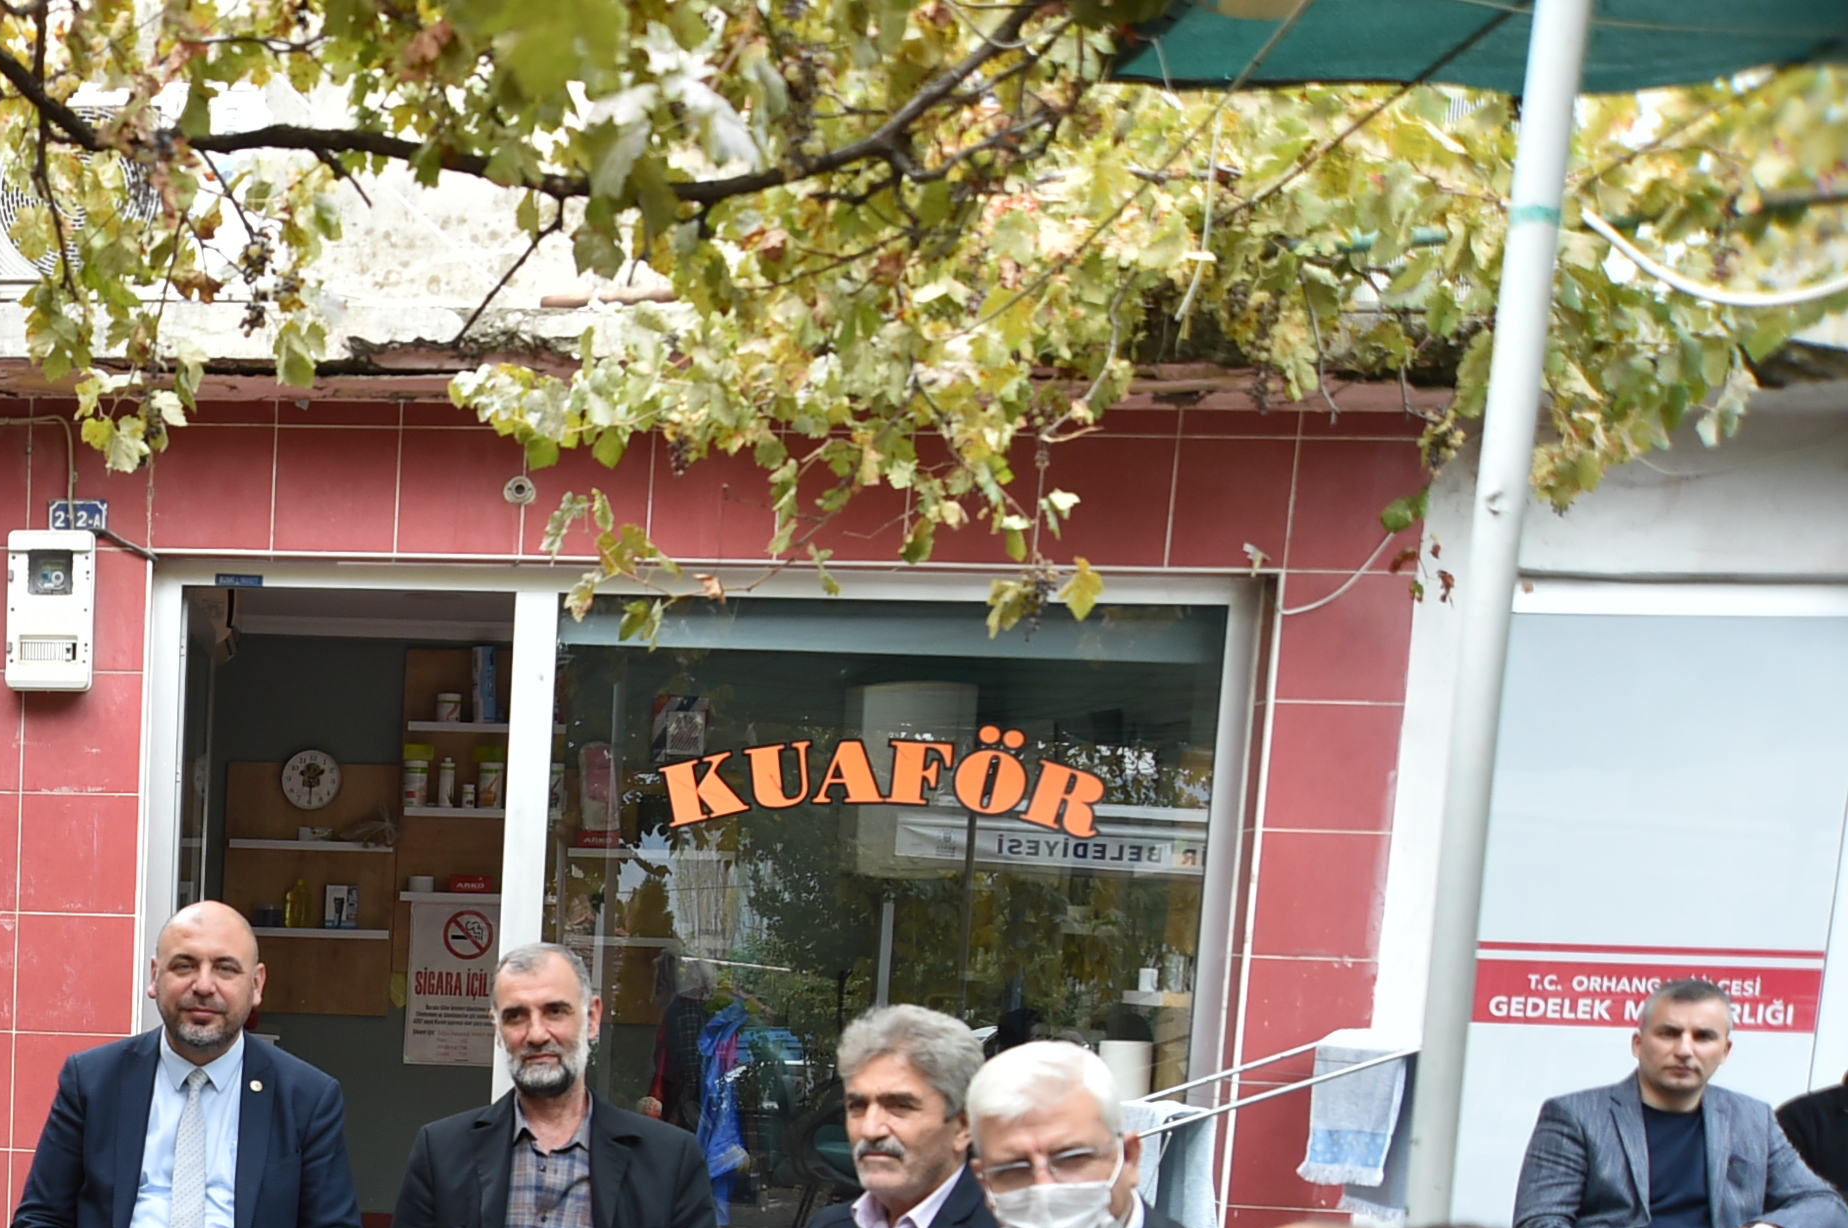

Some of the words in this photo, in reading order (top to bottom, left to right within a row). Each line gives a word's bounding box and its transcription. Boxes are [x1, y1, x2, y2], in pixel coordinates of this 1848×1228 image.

[659, 724, 1105, 838] KUAFÖR
[583, 836, 613, 844] ARKO
[456, 881, 485, 889] ARKO
[415, 966, 462, 996] SİGARA
[465, 967, 494, 1001] İÇİL
[1527, 973, 1562, 992] T.C.
[1488, 995, 1611, 1021] GEDELEK
